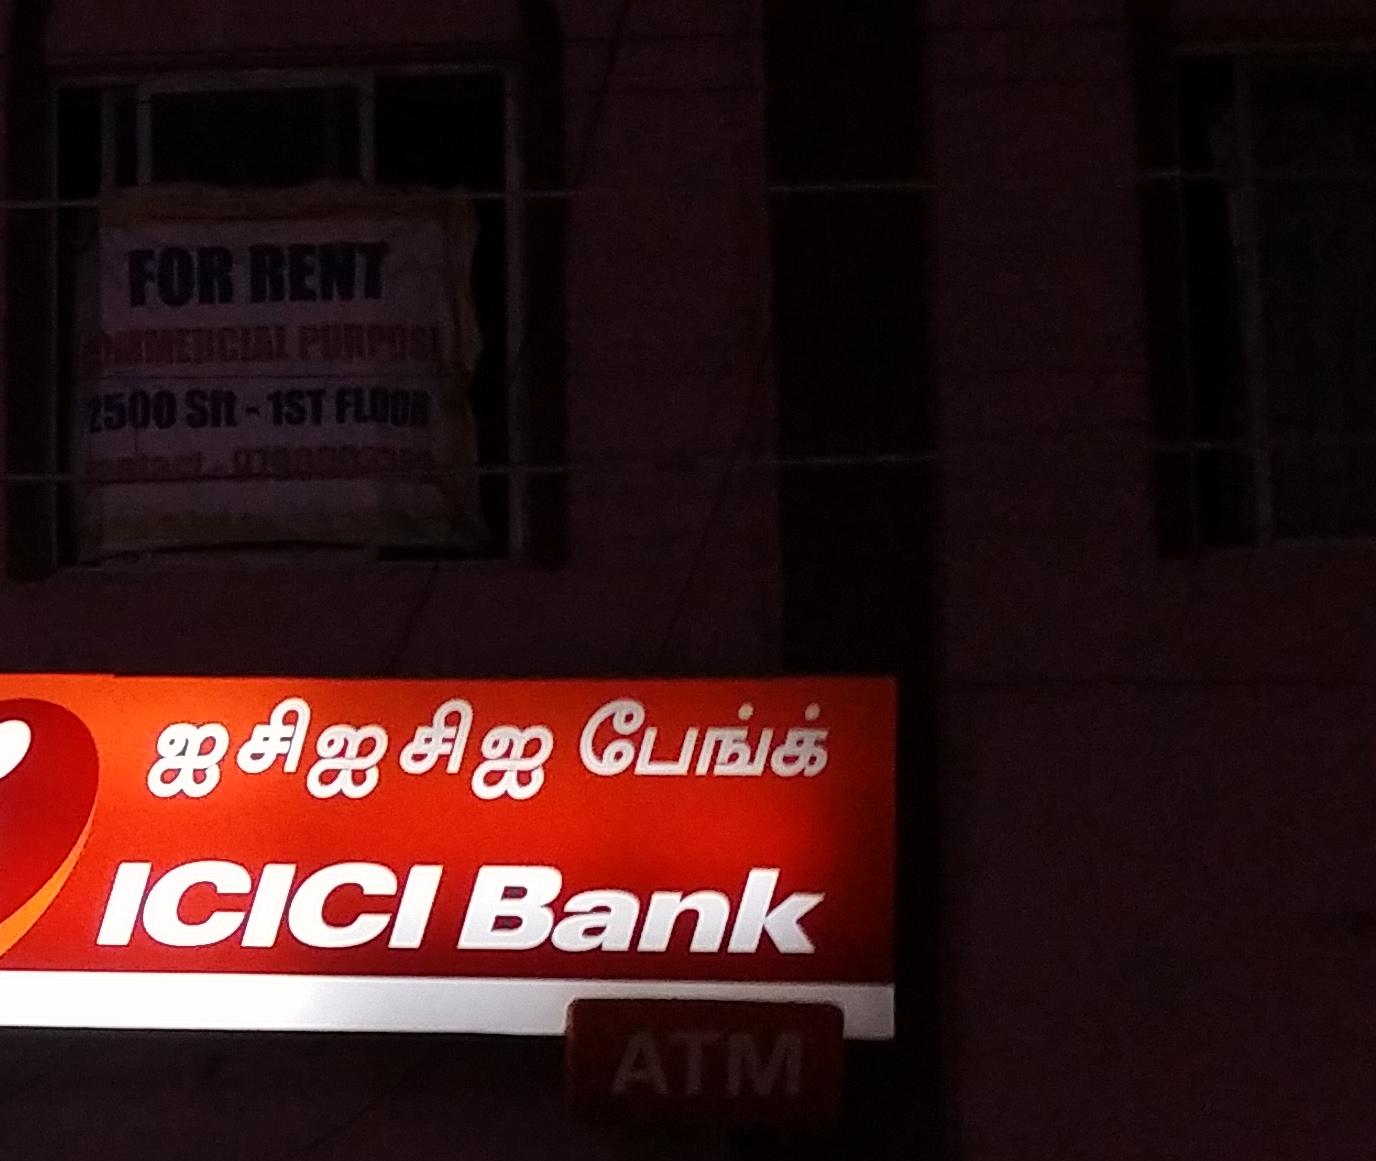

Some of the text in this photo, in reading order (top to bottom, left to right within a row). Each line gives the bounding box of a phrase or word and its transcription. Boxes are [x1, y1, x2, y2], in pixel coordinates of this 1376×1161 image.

[128, 241, 391, 306] FOR RENT
[89, 390, 177, 433] 2500
[186, 389, 238, 428] Sft
[266, 390, 327, 426] 1ST
[335, 388, 430, 428] FLOOR
[577, 695, 830, 779] பேங்க்
[95, 860, 828, 955] ICICI Bank
[609, 1030, 804, 1098] ATM
